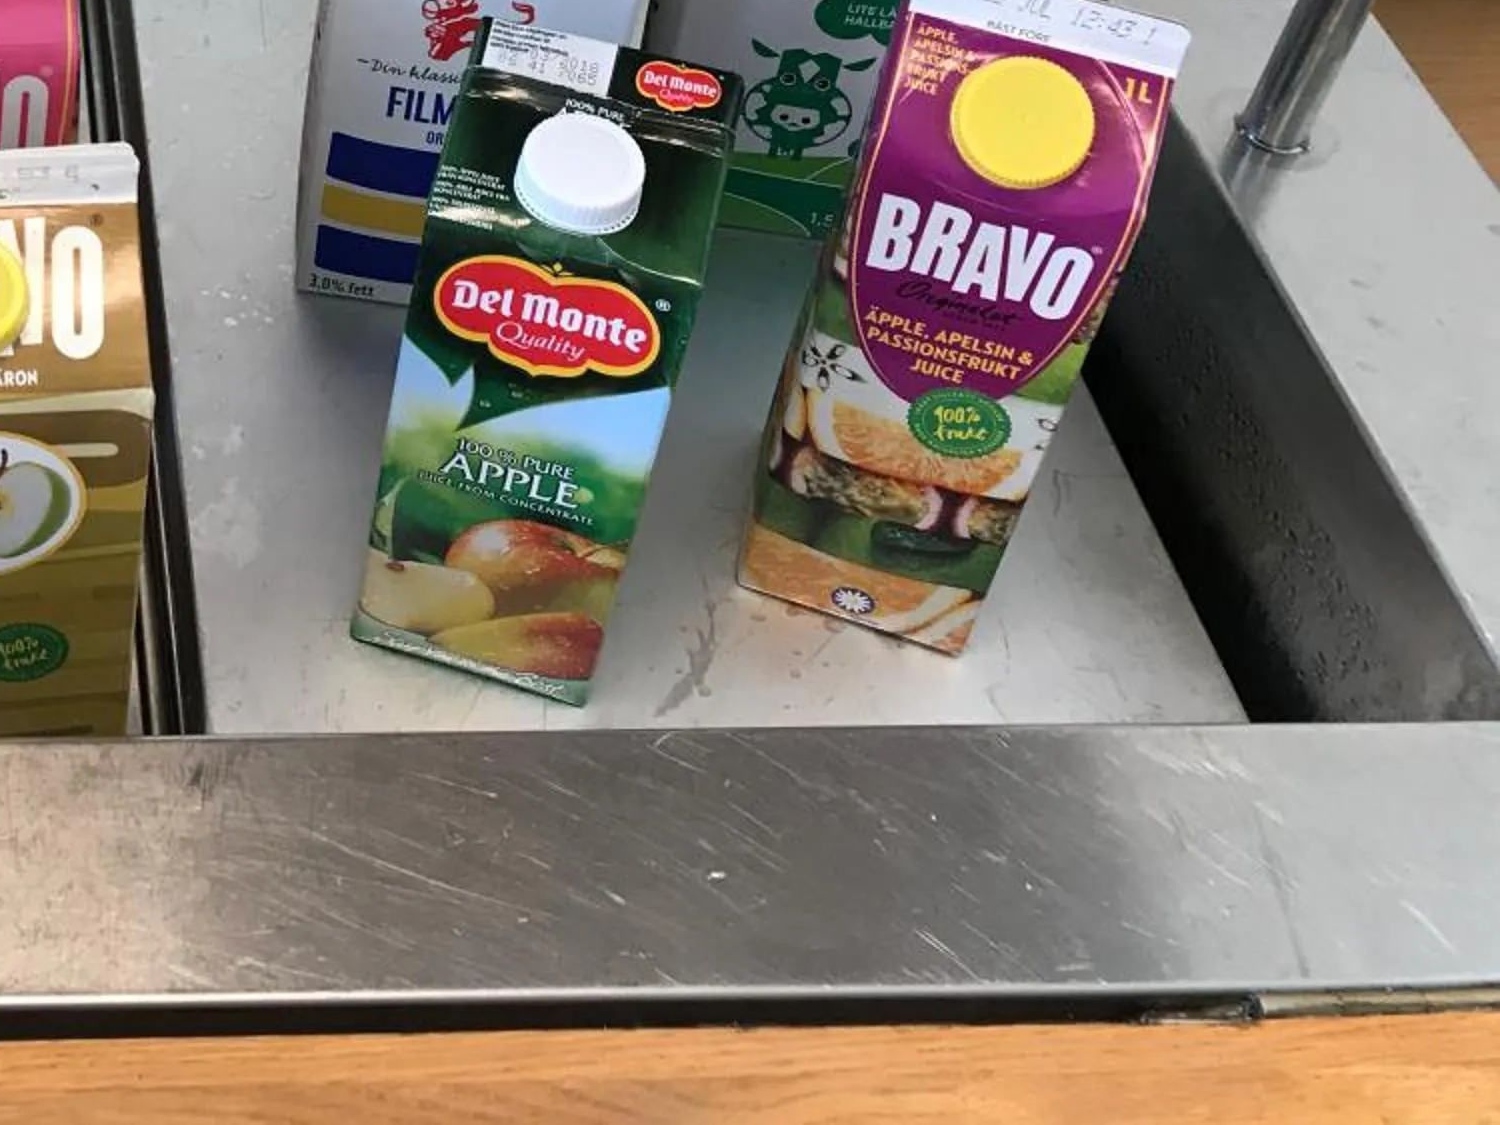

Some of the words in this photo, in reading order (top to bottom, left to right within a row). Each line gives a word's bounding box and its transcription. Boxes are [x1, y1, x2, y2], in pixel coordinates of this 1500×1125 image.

[643, 69, 669, 88] Del
[670, 75, 719, 102] Monte
[865, 192, 1096, 320] BRAVO
[451, 279, 514, 317] Del
[521, 291, 648, 354] Monte
[495, 320, 586, 362] Quality
[867, 328, 1021, 380] PASSIONSFRUKT
[936, 330, 1015, 360] APELSIN
[1018, 351, 1034, 367] &
[910, 359, 964, 384] JUICE
[440, 453, 579, 510] APPLE
[523, 455, 576, 481] PURE
[457, 481, 495, 501] FROM
[499, 492, 596, 526] CONCENTRATE
